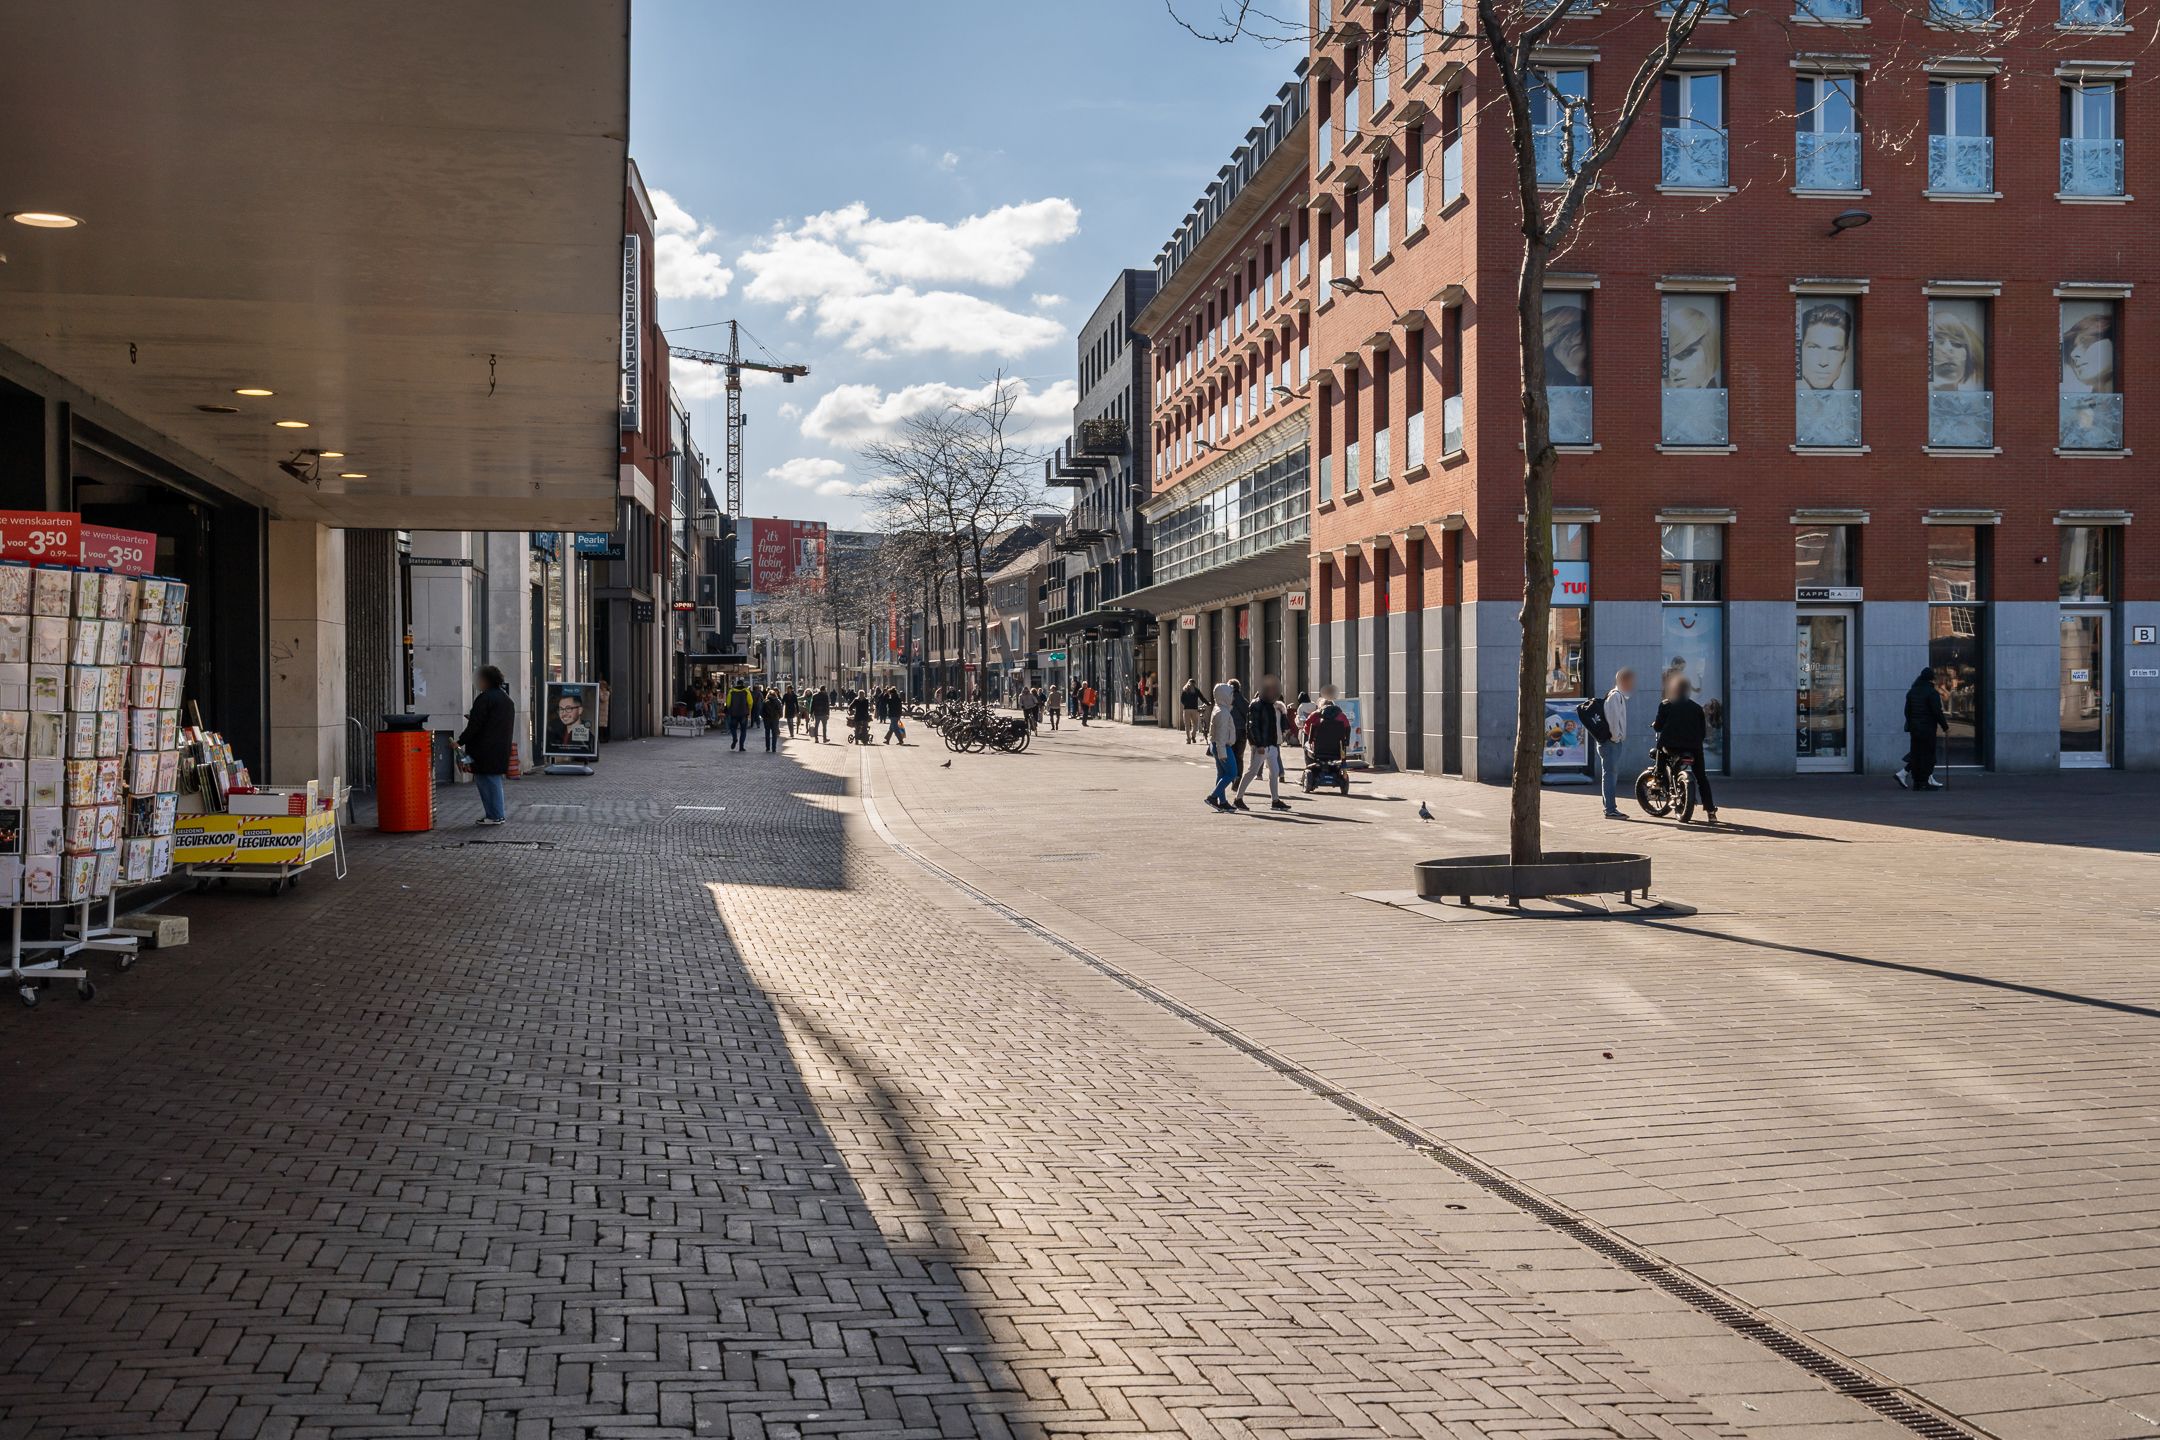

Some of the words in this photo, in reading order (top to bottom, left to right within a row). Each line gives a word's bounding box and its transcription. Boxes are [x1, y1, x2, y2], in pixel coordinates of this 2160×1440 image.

[10, 516, 73, 526] wenskaarten
[7, 539, 28, 547] voor
[93, 531, 149, 545] wenskaarten
[578, 535, 605, 544] Pearle
[757, 538, 786, 557] finger
[88, 551, 107, 559] voor
[408, 558, 443, 566] Statenplein
[126, 564, 142, 572] 0.99
[1562, 581, 1587, 594] TUI
[1289, 595, 1304, 606] H&M
[1183, 618, 1195, 626] H&M
[1799, 631, 1808, 747] KAPPERAZZI
[175, 833, 235, 847] EEGVERKOOP
[237, 835, 302, 848] LEEGVERKOOP
